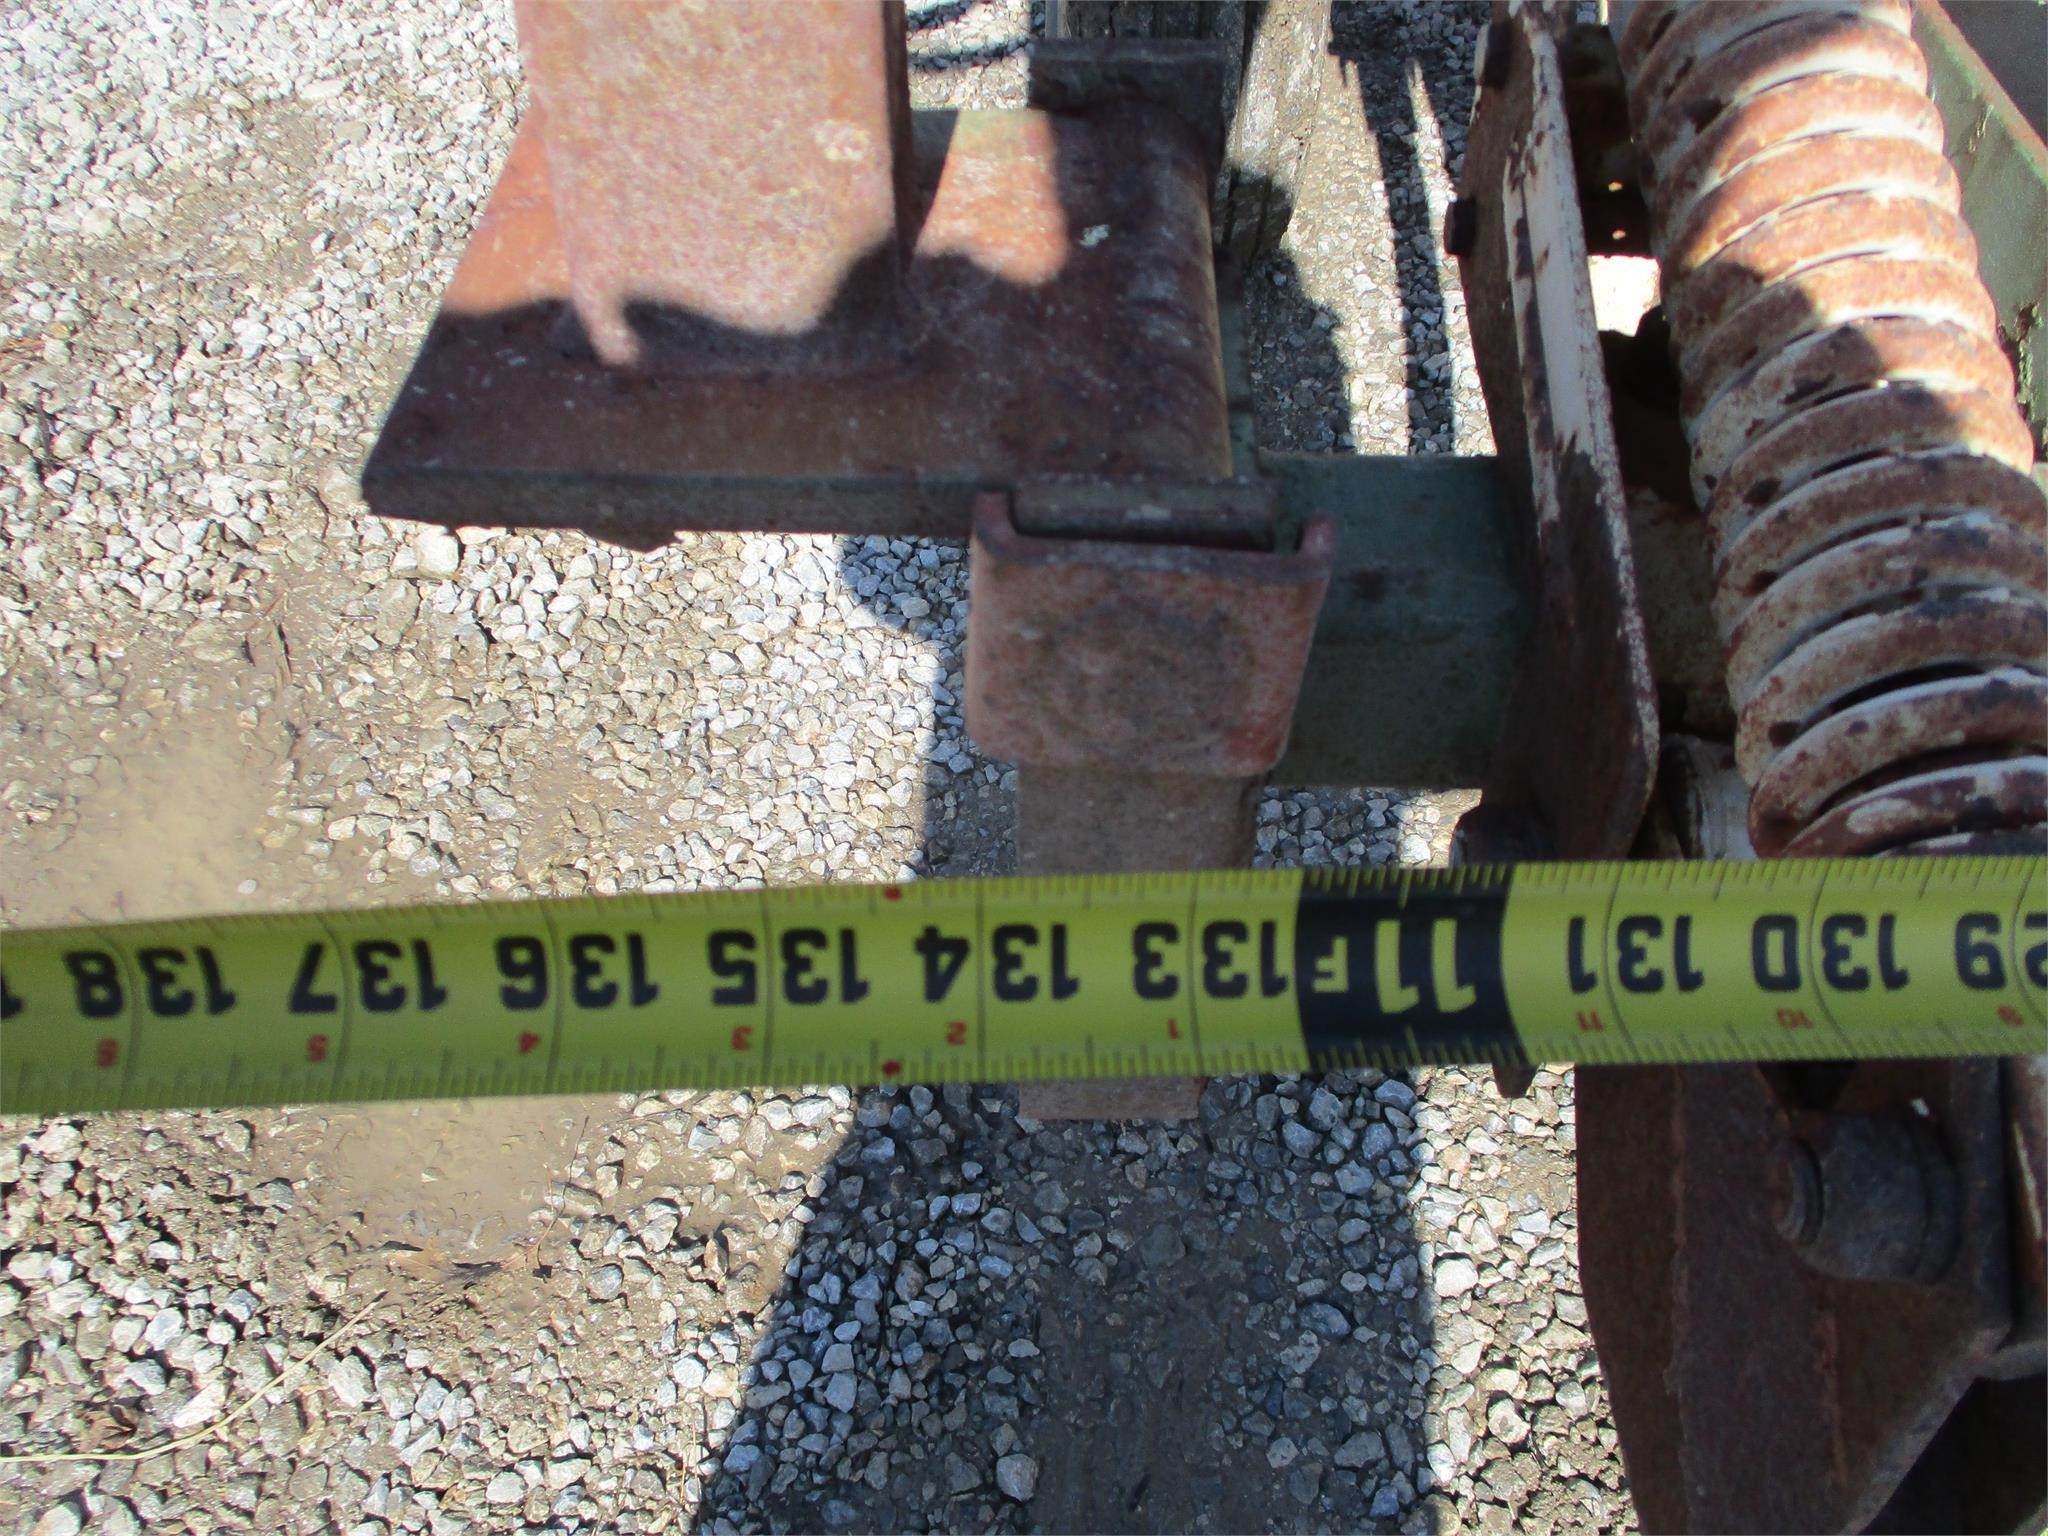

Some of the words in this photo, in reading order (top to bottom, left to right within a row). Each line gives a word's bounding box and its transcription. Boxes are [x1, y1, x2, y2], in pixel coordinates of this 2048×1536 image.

[61, 945, 238, 1020] 138
[288, 937, 449, 1015] 137
[494, 932, 659, 1011] 136
[706, 926, 869, 1007] 135
[914, 922, 1080, 1004] 134
[1132, 919, 1288, 1001] 133
[1567, 914, 1705, 995] 131
[1752, 912, 1909, 993] 130
[517, 1030, 541, 1055] 4
[731, 1025, 753, 1051] 3
[946, 1020, 968, 1047] 2
[1166, 1018, 1181, 1041] 1
